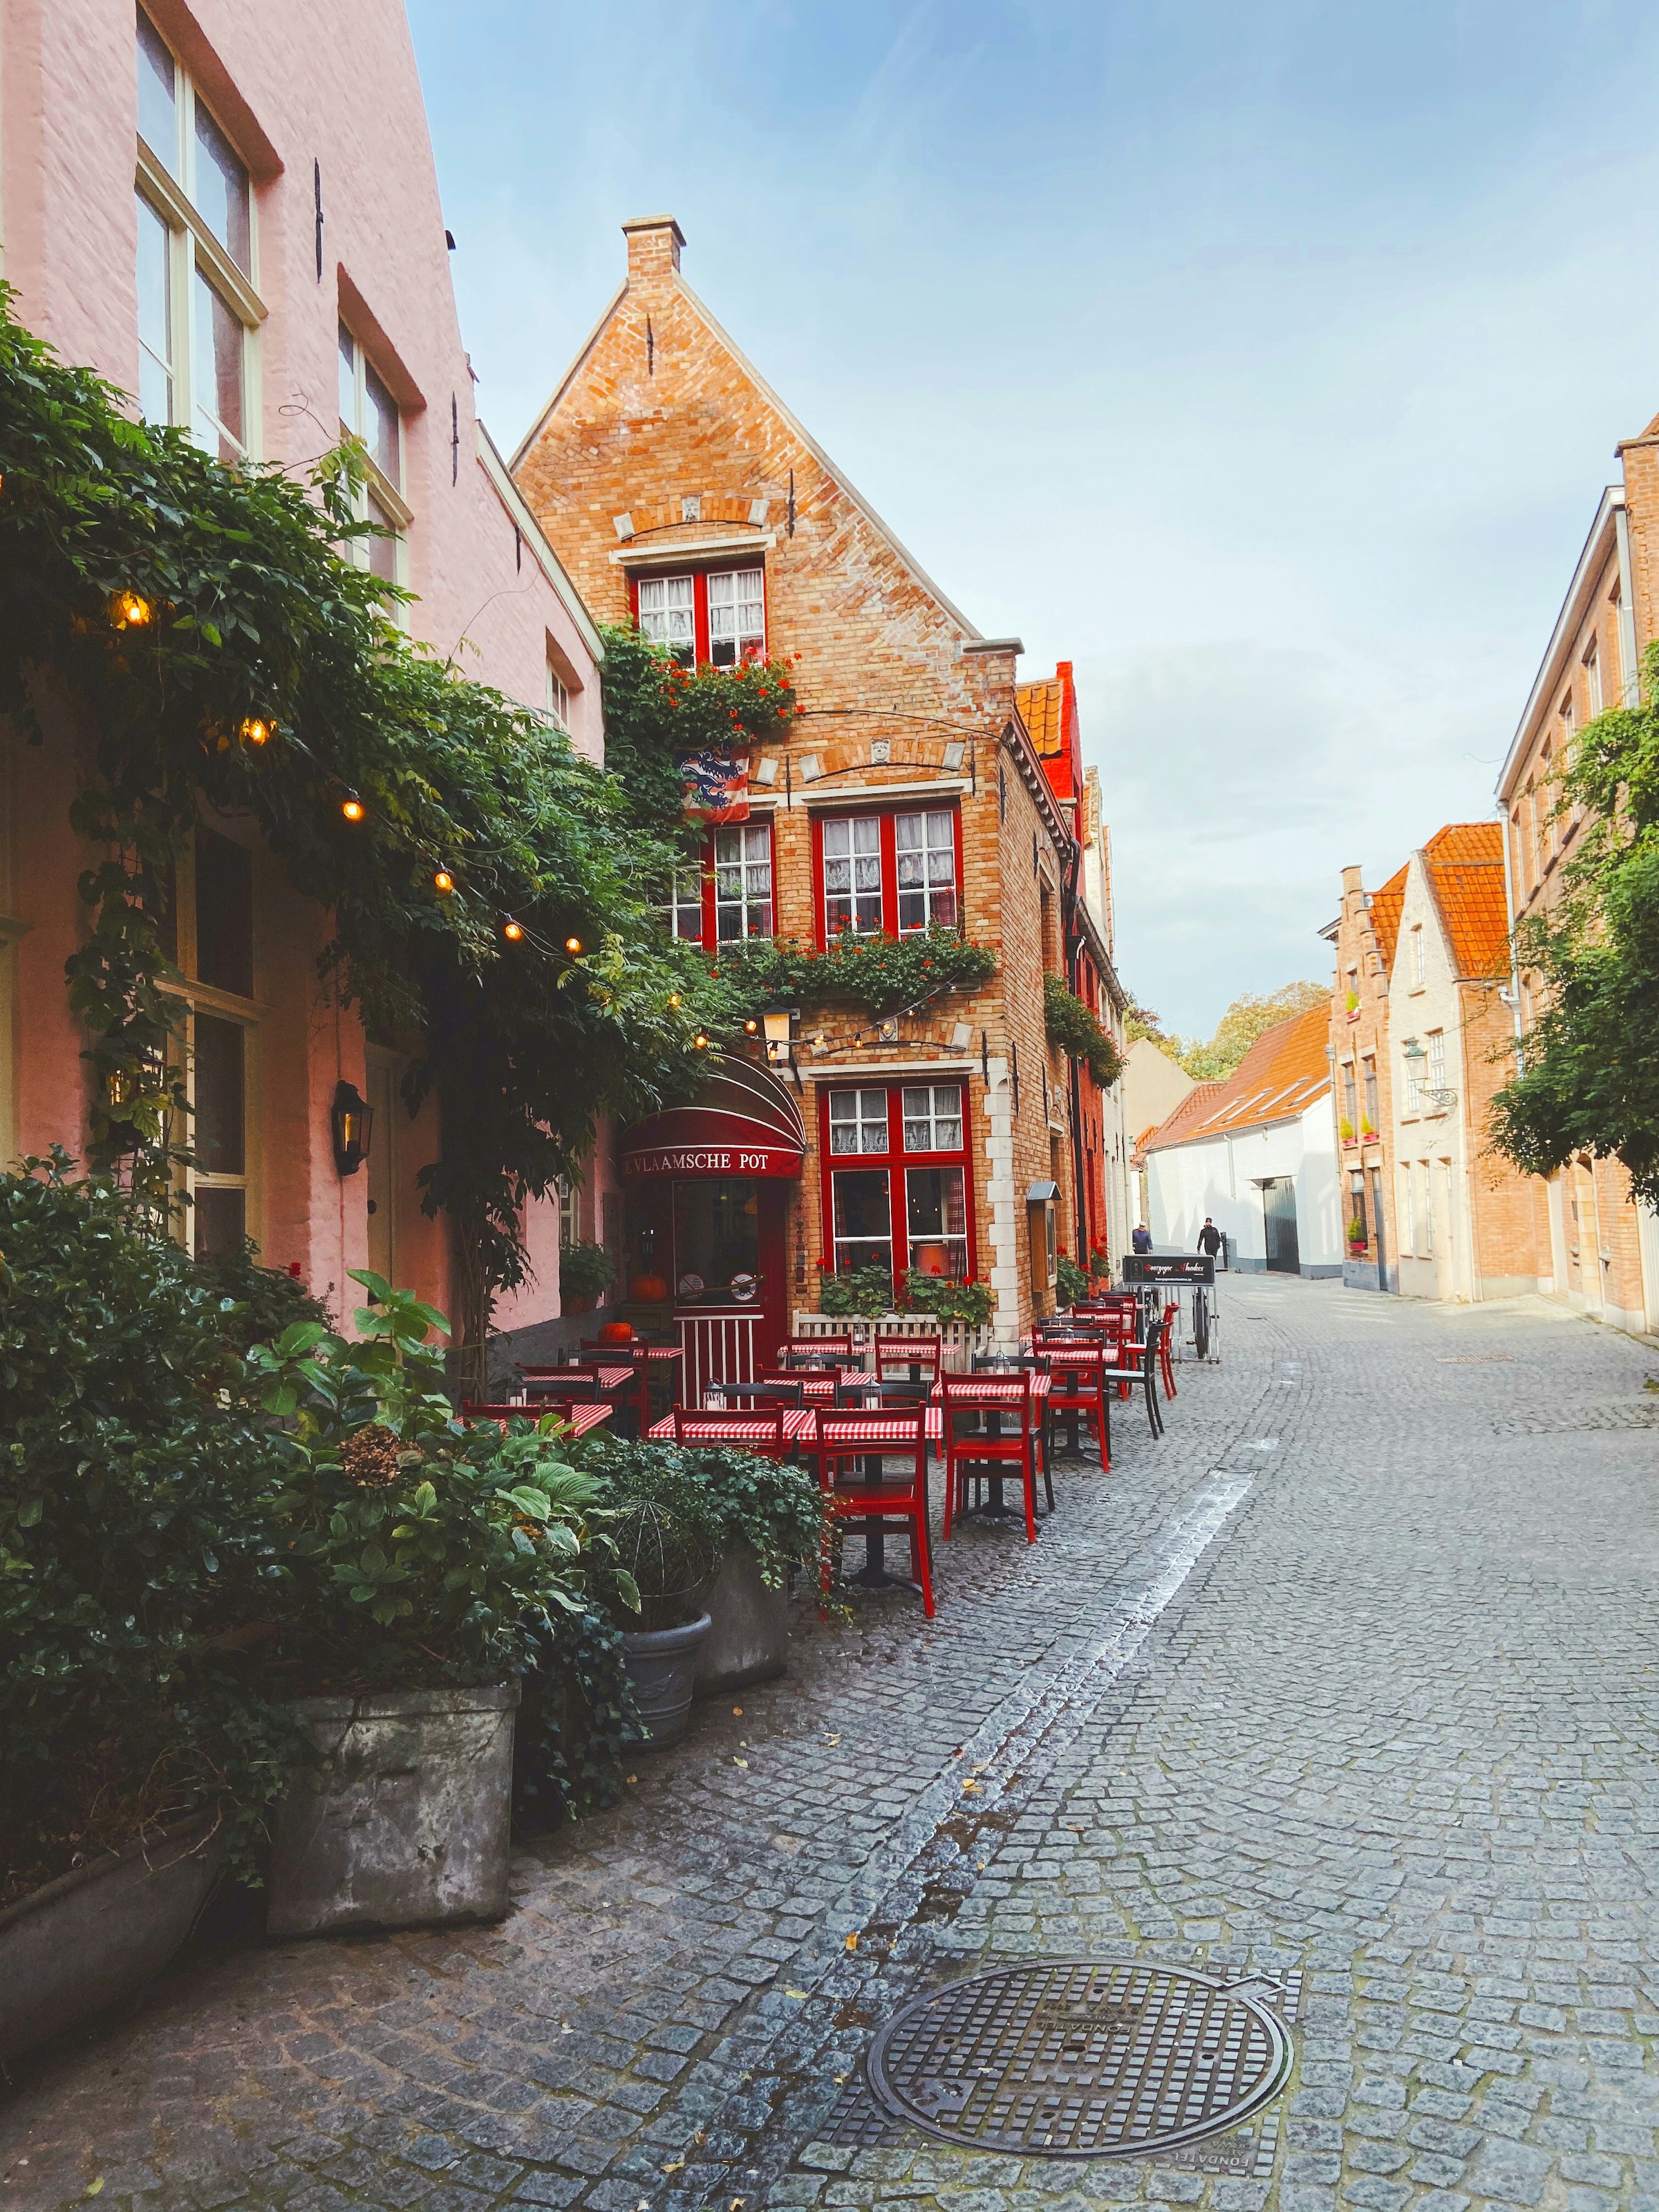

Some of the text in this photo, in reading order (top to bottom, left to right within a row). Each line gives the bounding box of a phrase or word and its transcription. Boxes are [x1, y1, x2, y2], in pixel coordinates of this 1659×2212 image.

[634, 1153, 731, 1172] VLAAMSCHE
[739, 1154, 768, 1170] POT
[1035, 2021, 1131, 2034] FONDATEL
[1171, 2153, 1250, 2168] FONDATEL
